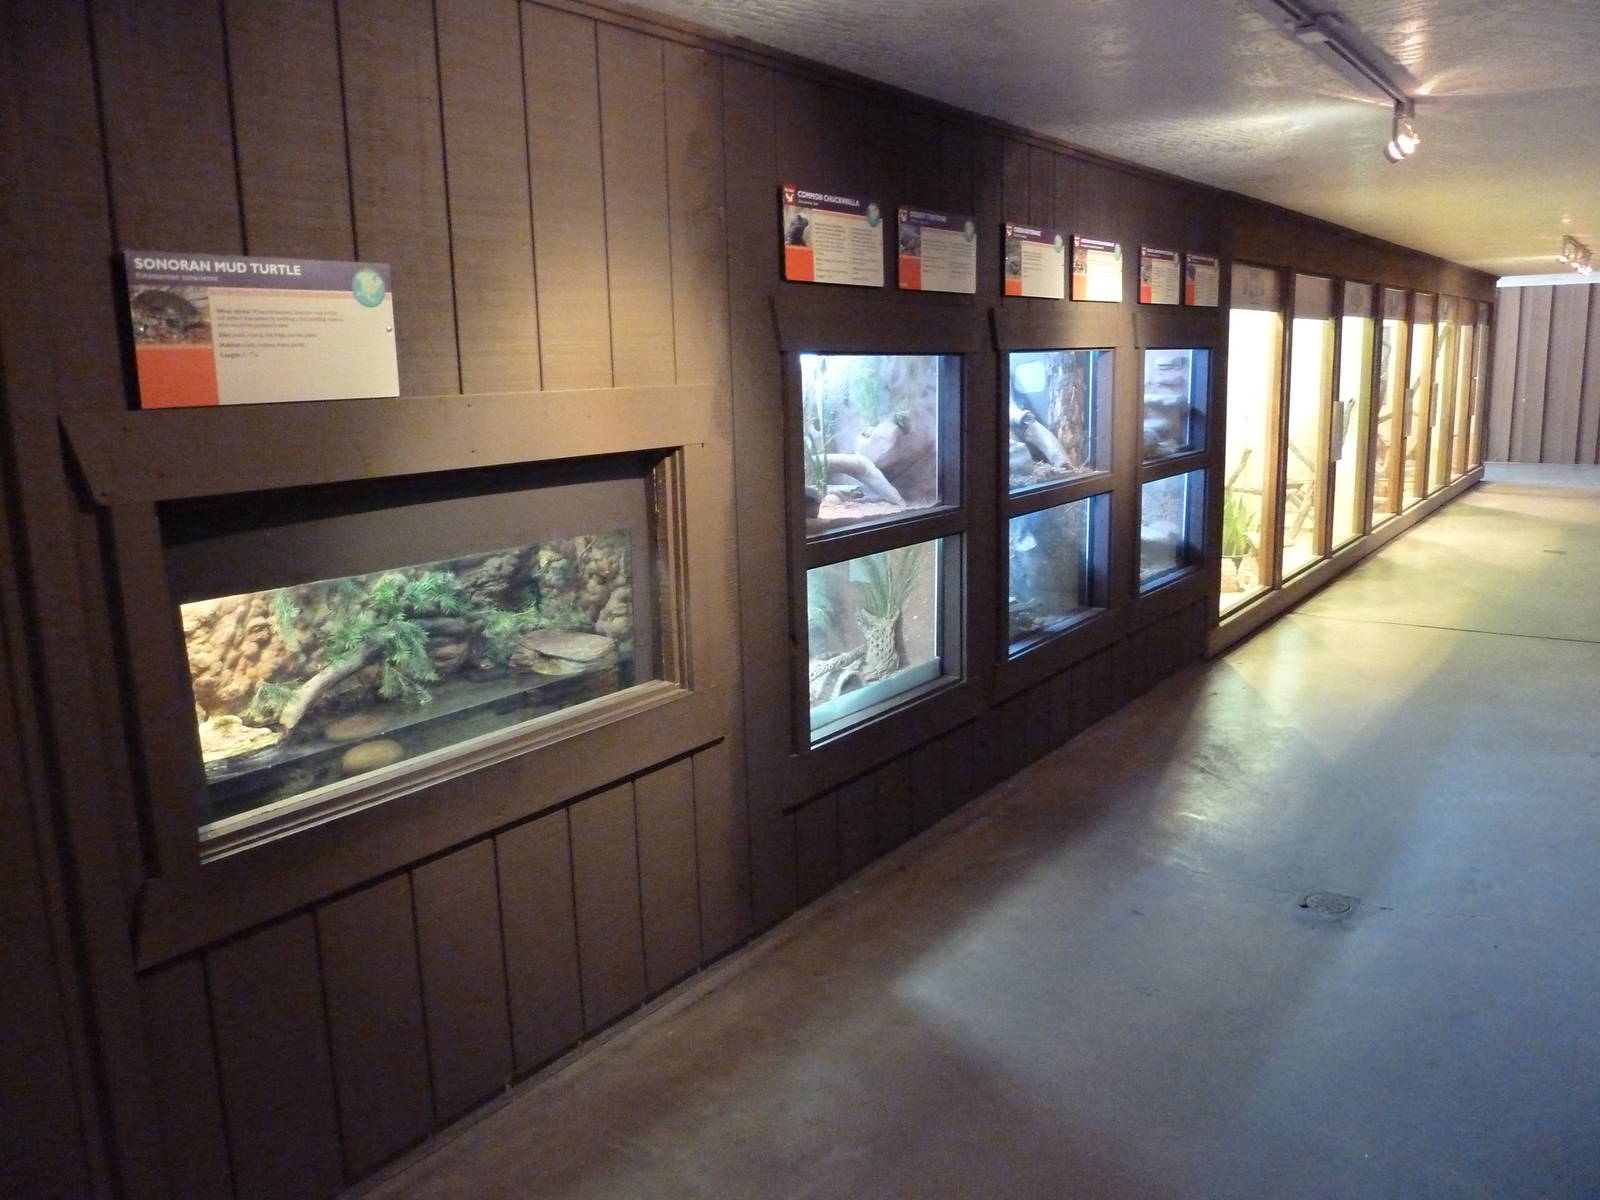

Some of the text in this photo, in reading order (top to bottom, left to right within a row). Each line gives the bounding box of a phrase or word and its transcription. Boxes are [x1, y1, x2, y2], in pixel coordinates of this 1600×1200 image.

[134, 258, 302, 276] SONORAN MUD TURTLE
